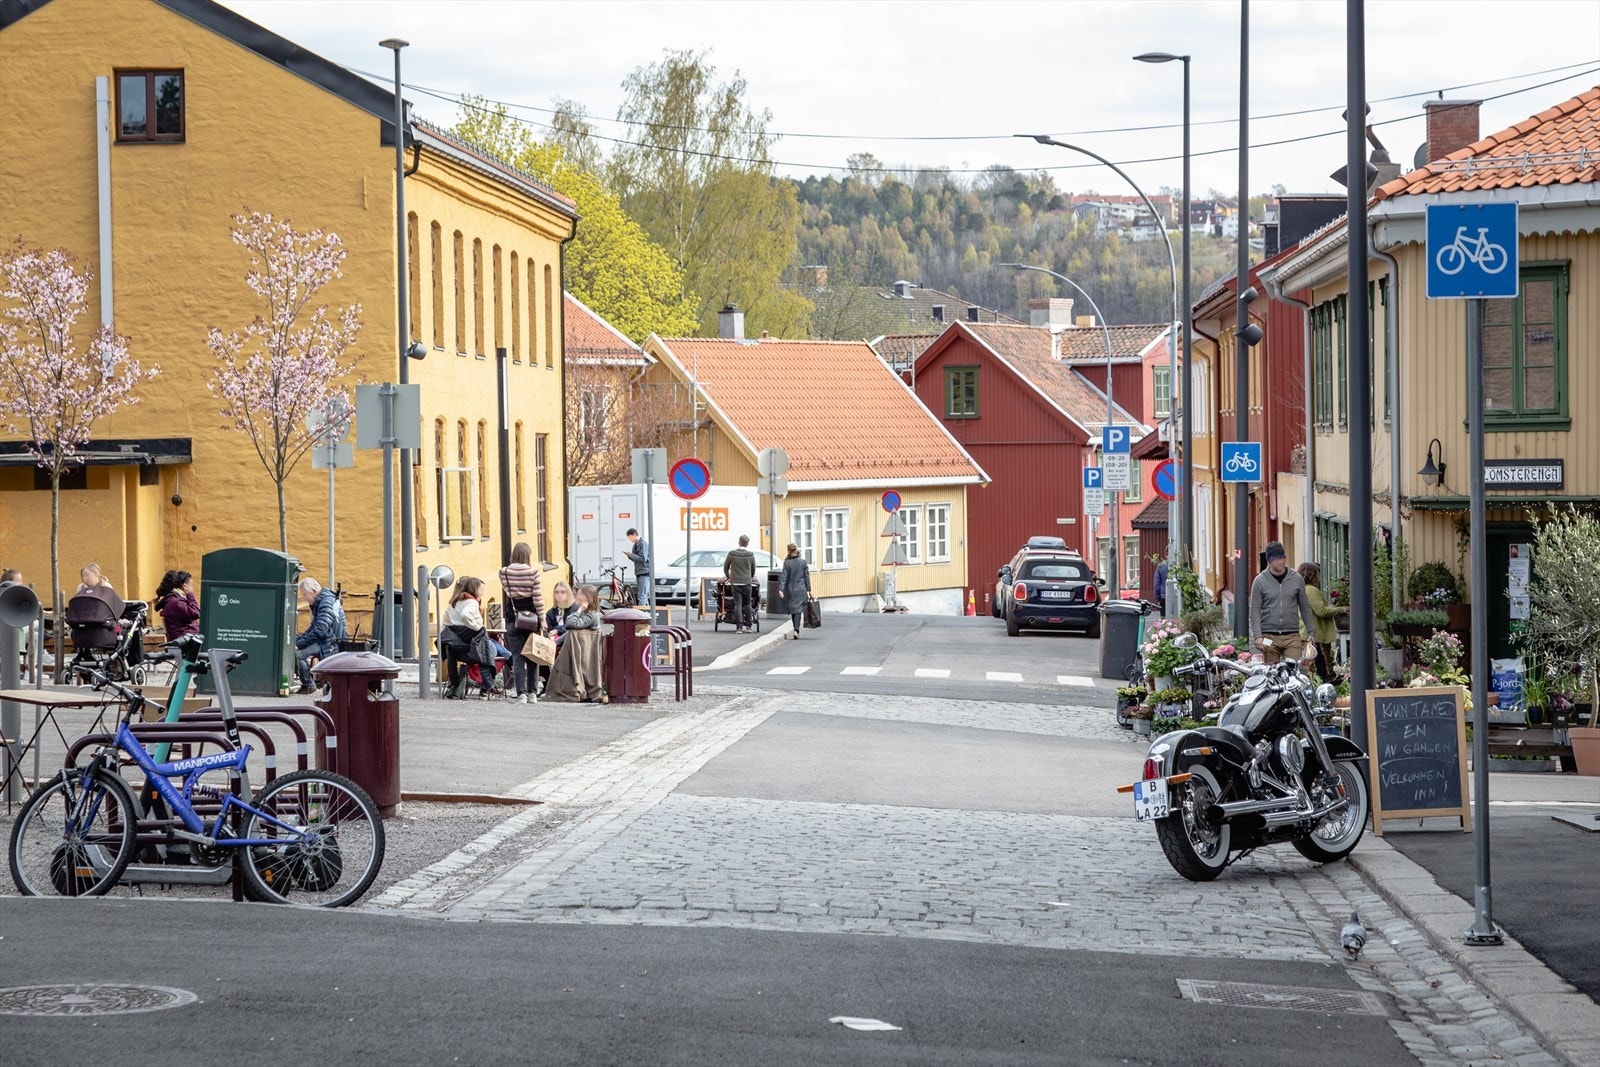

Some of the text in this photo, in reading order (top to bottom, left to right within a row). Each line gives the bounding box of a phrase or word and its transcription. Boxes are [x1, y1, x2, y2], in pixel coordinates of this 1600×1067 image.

[1109, 430, 1124, 450] P
[1088, 470, 1100, 486] P
[1382, 702, 1408, 718] KUN
[1404, 724, 1426, 739] EN
[1385, 744, 1398, 758] AV
[174, 752, 237, 771] MANPOWER
[1150, 782, 1157, 792] B
[1382, 770, 1445, 788] VELKOMMEN
[1137, 805, 1167, 819] LA 22
